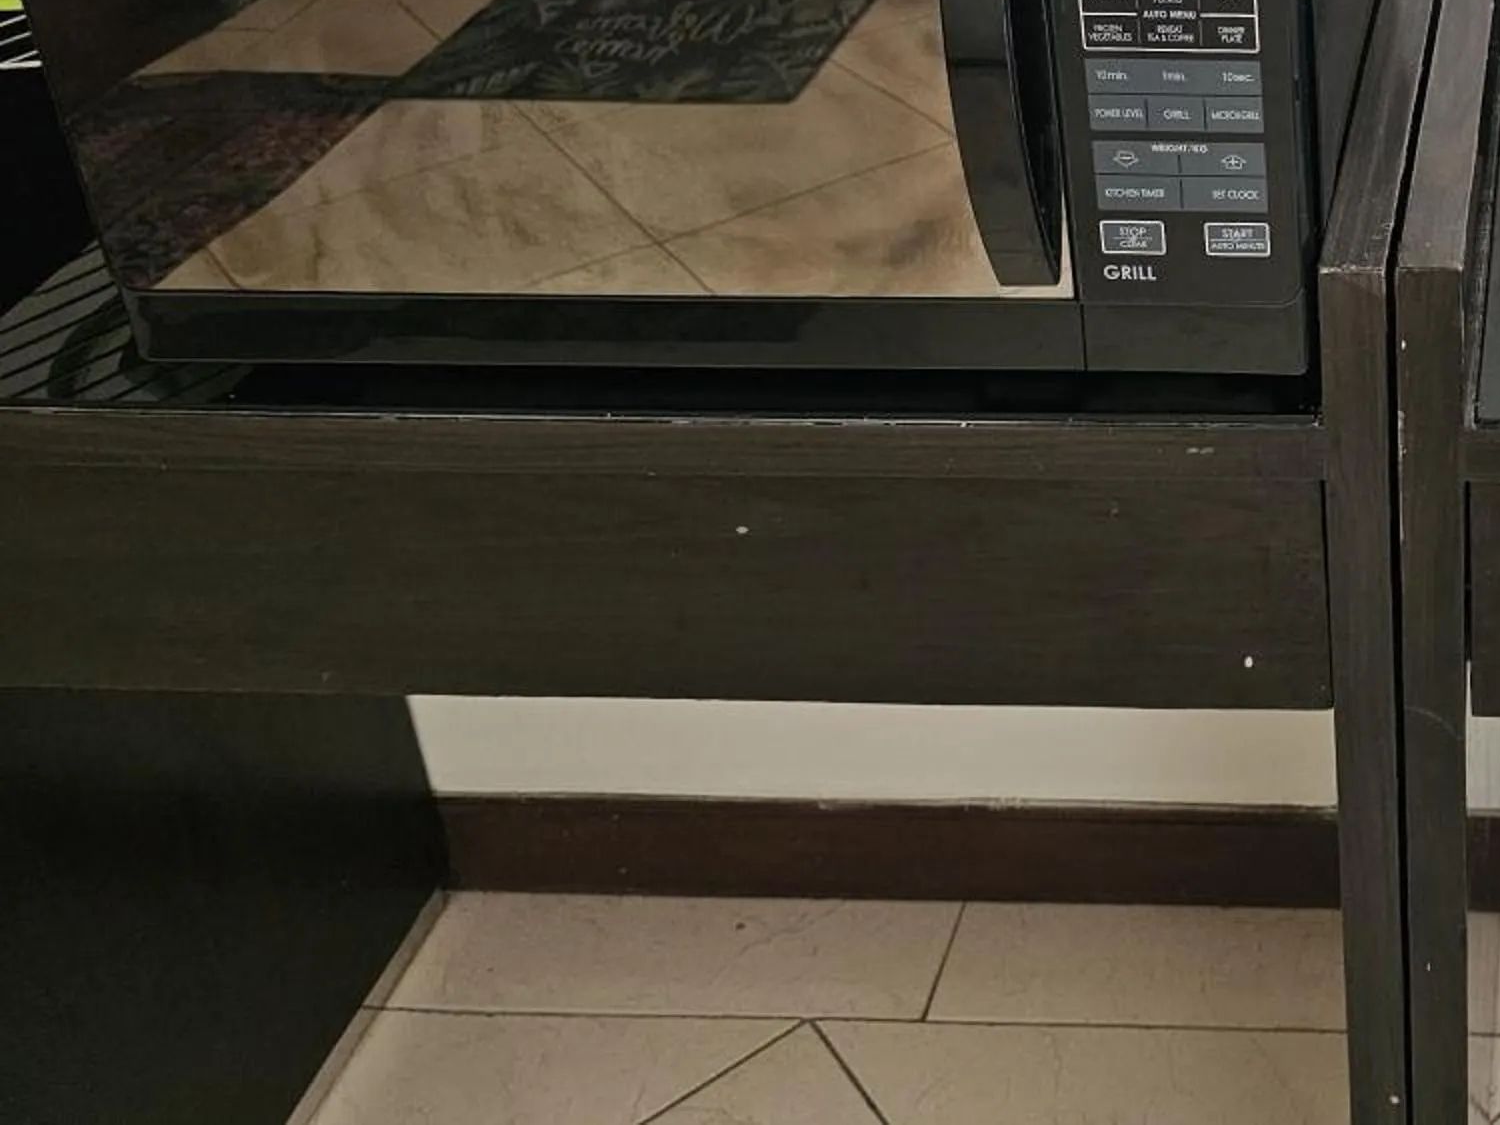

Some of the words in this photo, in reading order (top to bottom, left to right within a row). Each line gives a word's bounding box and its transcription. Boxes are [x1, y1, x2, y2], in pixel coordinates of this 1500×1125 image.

[1143, 10, 1167, 19] AUTO
[1169, 11, 1197, 20] MENU
[1119, 227, 1147, 237] STOP
[1221, 228, 1254, 238] START
[1103, 264, 1157, 281] GRILL
